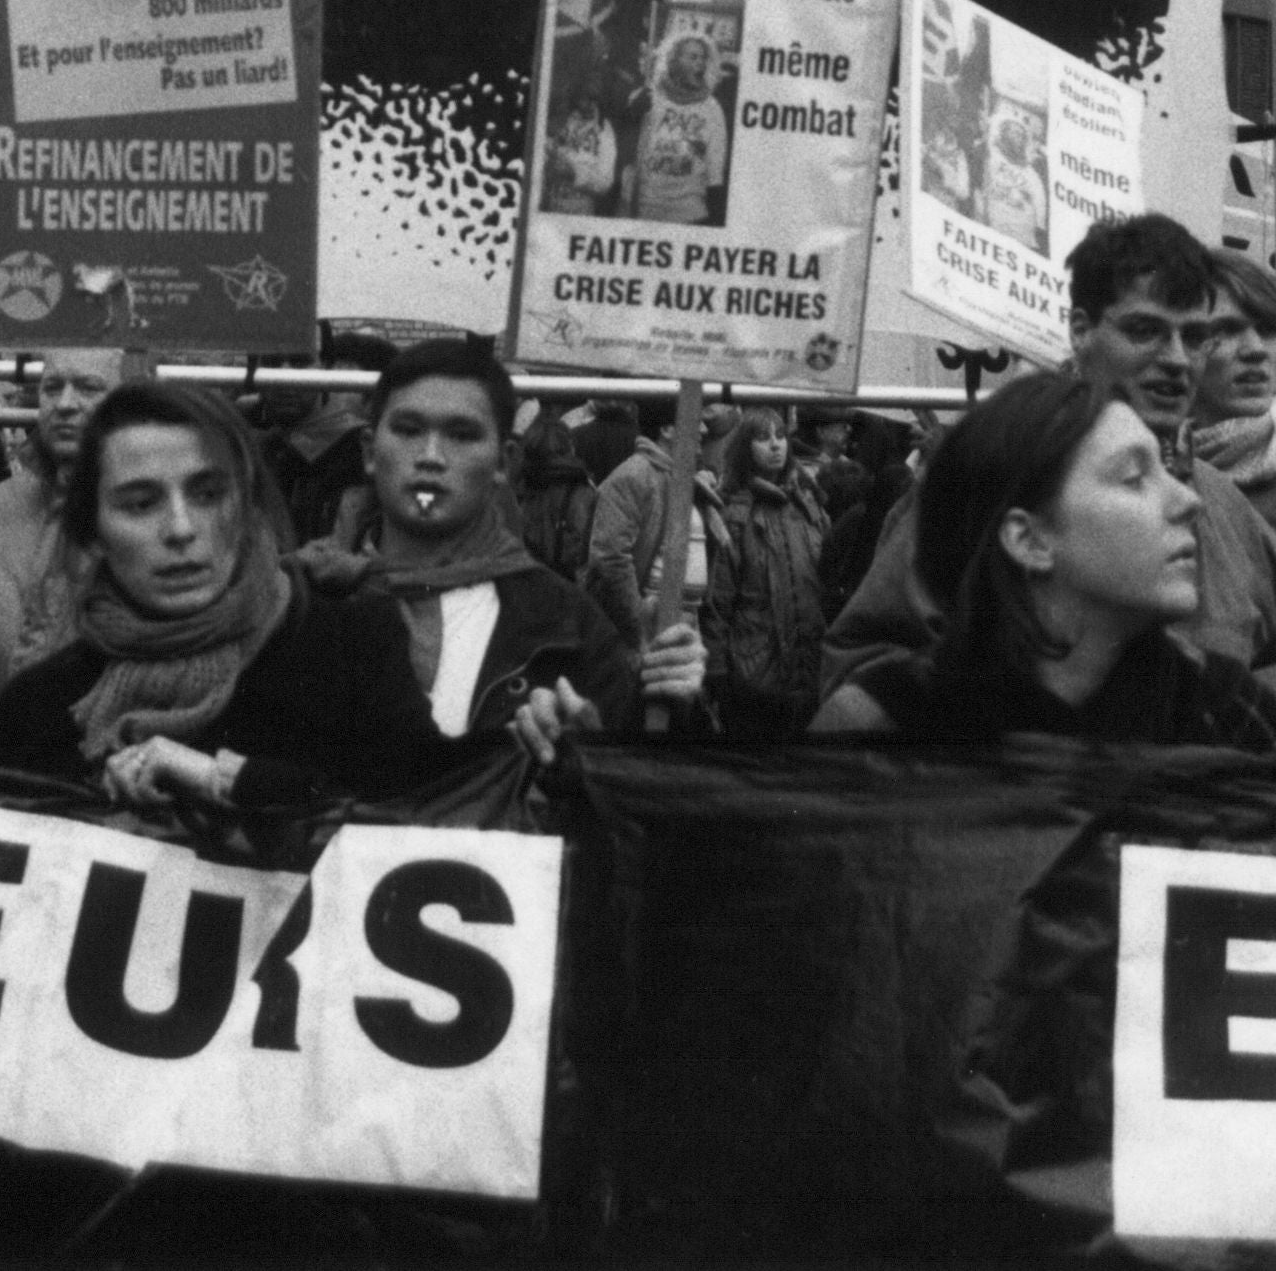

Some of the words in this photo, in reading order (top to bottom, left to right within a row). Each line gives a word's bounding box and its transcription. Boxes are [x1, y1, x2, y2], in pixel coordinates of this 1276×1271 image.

[17, 44, 42, 70] Et
[46, 43, 94, 75] pour
[99, 26, 265, 67] l'enseignement?
[756, 41, 851, 84] même
[160, 65, 197, 91] Pas
[202, 65, 230, 89] un
[235, 57, 289, 86] liard!
[741, 98, 858, 139] combat
[254, 141, 295, 184] DE
[1060, 150, 1131, 195] même
[17, 186, 271, 233] L'ENSEIGNEMENT
[1054, 180, 1130, 226] comba
[568, 233, 673, 271] FAITES
[683, 243, 778, 278] PAYER
[786, 253, 822, 282] LA
[936, 241, 1000, 291] CRISE
[1008, 279, 1052, 318] AUX
[944, 218, 1018, 272] FAITES
[1025, 261, 1065, 296] PAY
[554, 272, 644, 307] CRISE
[653, 281, 715, 315] AUX
[725, 285, 827, 322] RICHES
